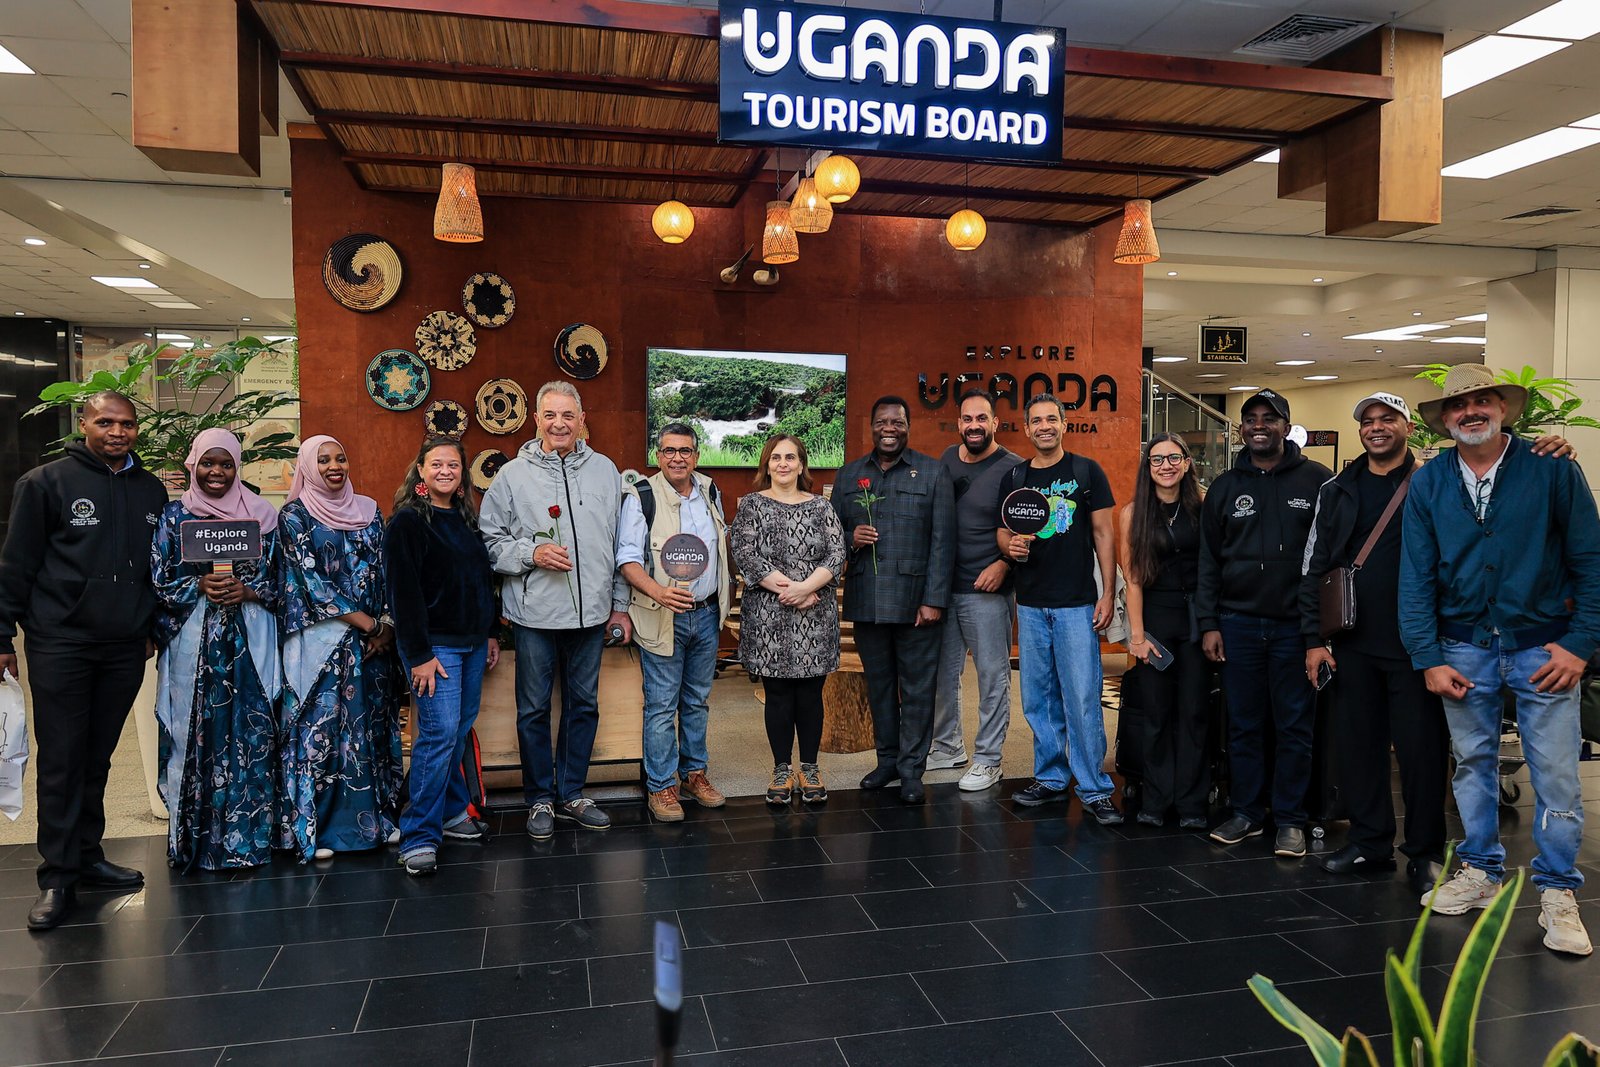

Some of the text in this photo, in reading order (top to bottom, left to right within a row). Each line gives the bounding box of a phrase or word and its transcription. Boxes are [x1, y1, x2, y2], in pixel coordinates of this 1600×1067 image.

[742, 8, 1050, 96] UGANDA
[743, 92, 1047, 146] TOURISM BOARD
[966, 346, 1075, 361] EXPLORE
[1067, 422, 1098, 433] RICA
[1008, 507, 1045, 516] UGANDA
[195, 528, 247, 540] #Explore
[205, 541, 248, 554] Uganda
[665, 552, 704, 561] UGANDA
